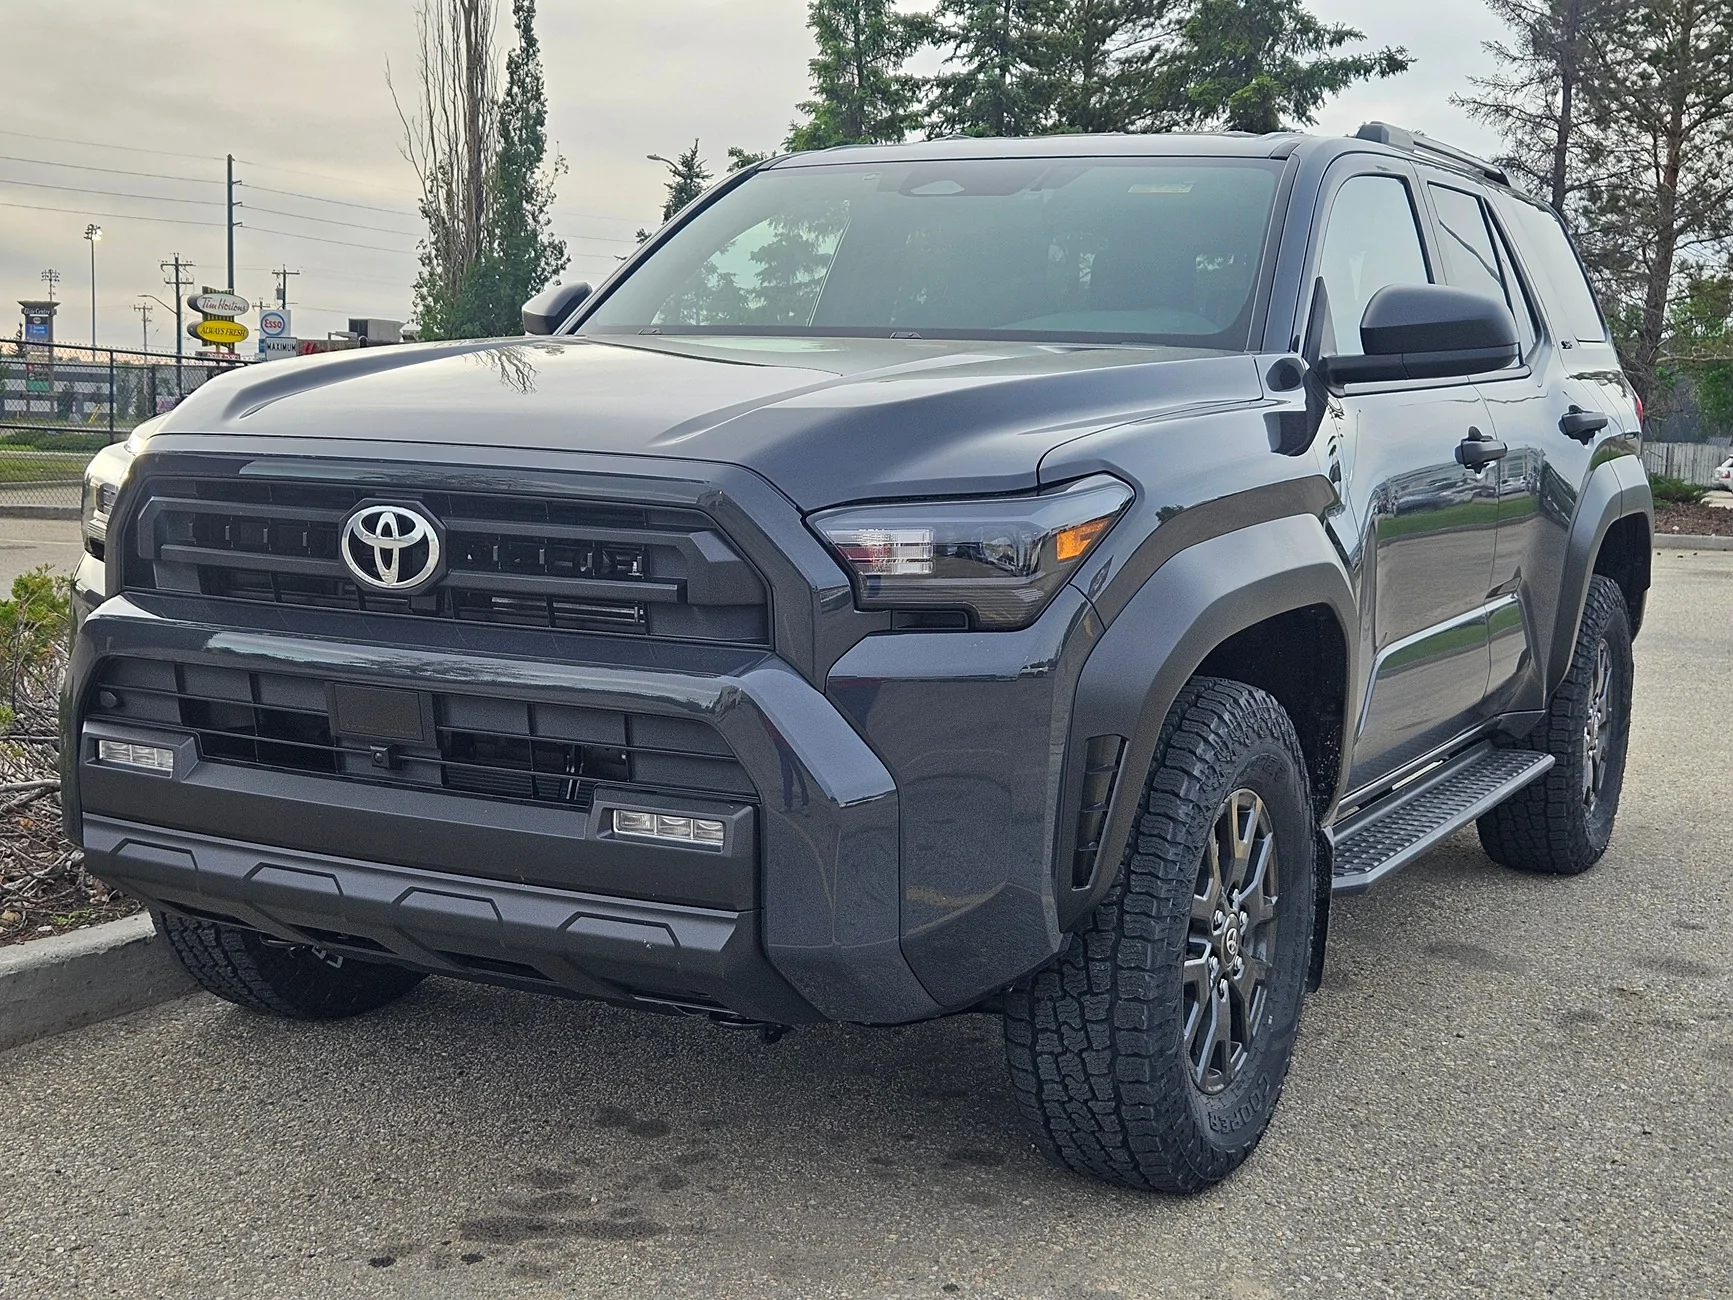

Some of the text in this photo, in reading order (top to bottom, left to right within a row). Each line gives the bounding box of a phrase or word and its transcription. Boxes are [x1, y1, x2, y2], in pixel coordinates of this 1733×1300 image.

[202, 296, 246, 312] Tim Hortons
[201, 327, 246, 337] ALWAYS FRESH
[266, 342, 296, 352] MAXIMUM
